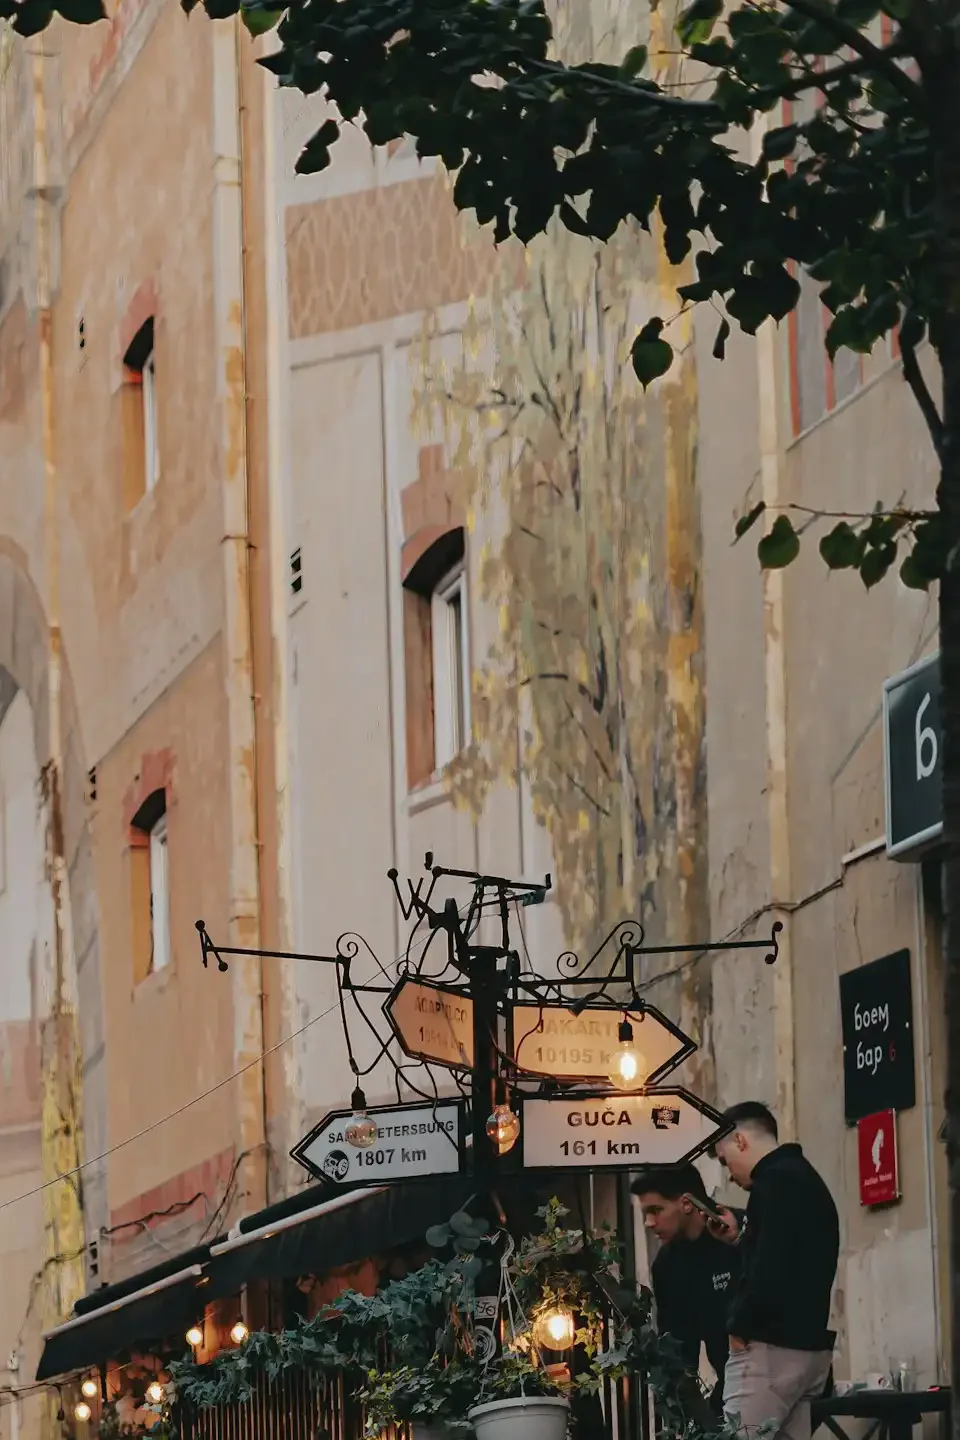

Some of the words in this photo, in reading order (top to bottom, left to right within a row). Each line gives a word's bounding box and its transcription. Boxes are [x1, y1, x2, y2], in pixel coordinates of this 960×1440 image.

[854, 1002, 889, 1032] боем
[535, 1019, 617, 1036] JAKART
[534, 1047, 593, 1064] 10195
[856, 1041, 883, 1076] бар
[567, 1106, 632, 1127] GUČA
[328, 1129, 362, 1144] SAIN
[559, 1140, 596, 1156] 161
[607, 1139, 640, 1155] km
[355, 1148, 395, 1167] 1807
[401, 1148, 427, 1163] km
